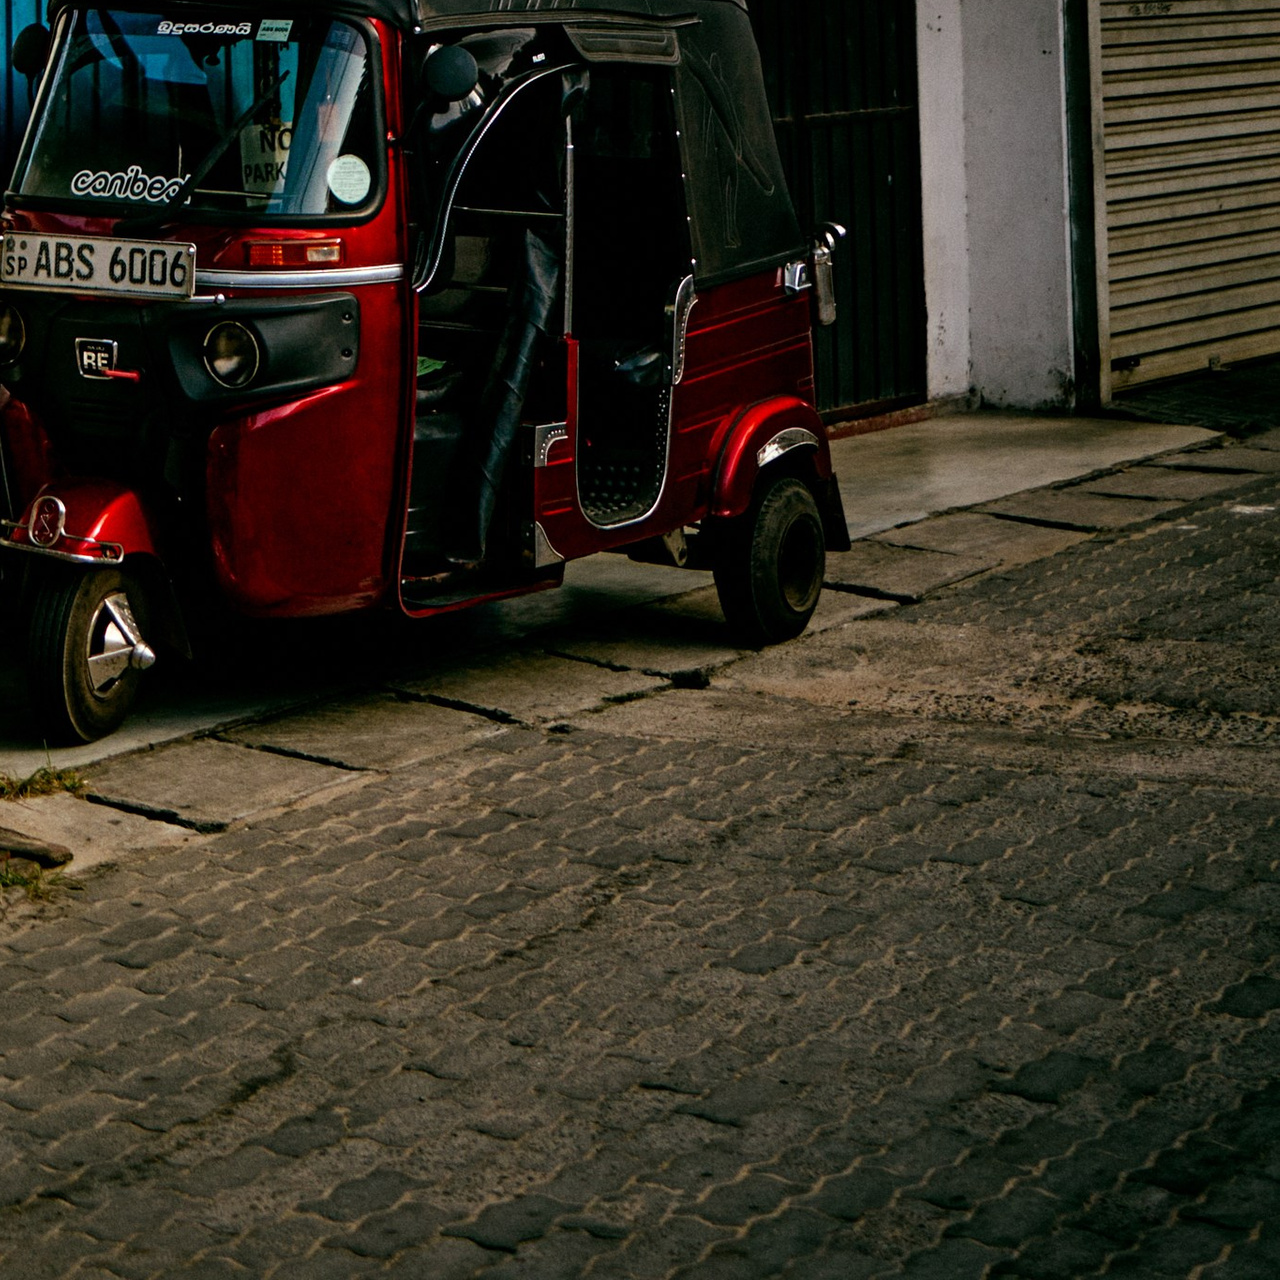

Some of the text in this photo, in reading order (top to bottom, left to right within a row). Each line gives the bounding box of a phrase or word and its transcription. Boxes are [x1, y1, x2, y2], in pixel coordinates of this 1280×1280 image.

[260, 128, 292, 153] NO
[5, 242, 188, 288] SP ABS 6006
[83, 351, 109, 371] RE
